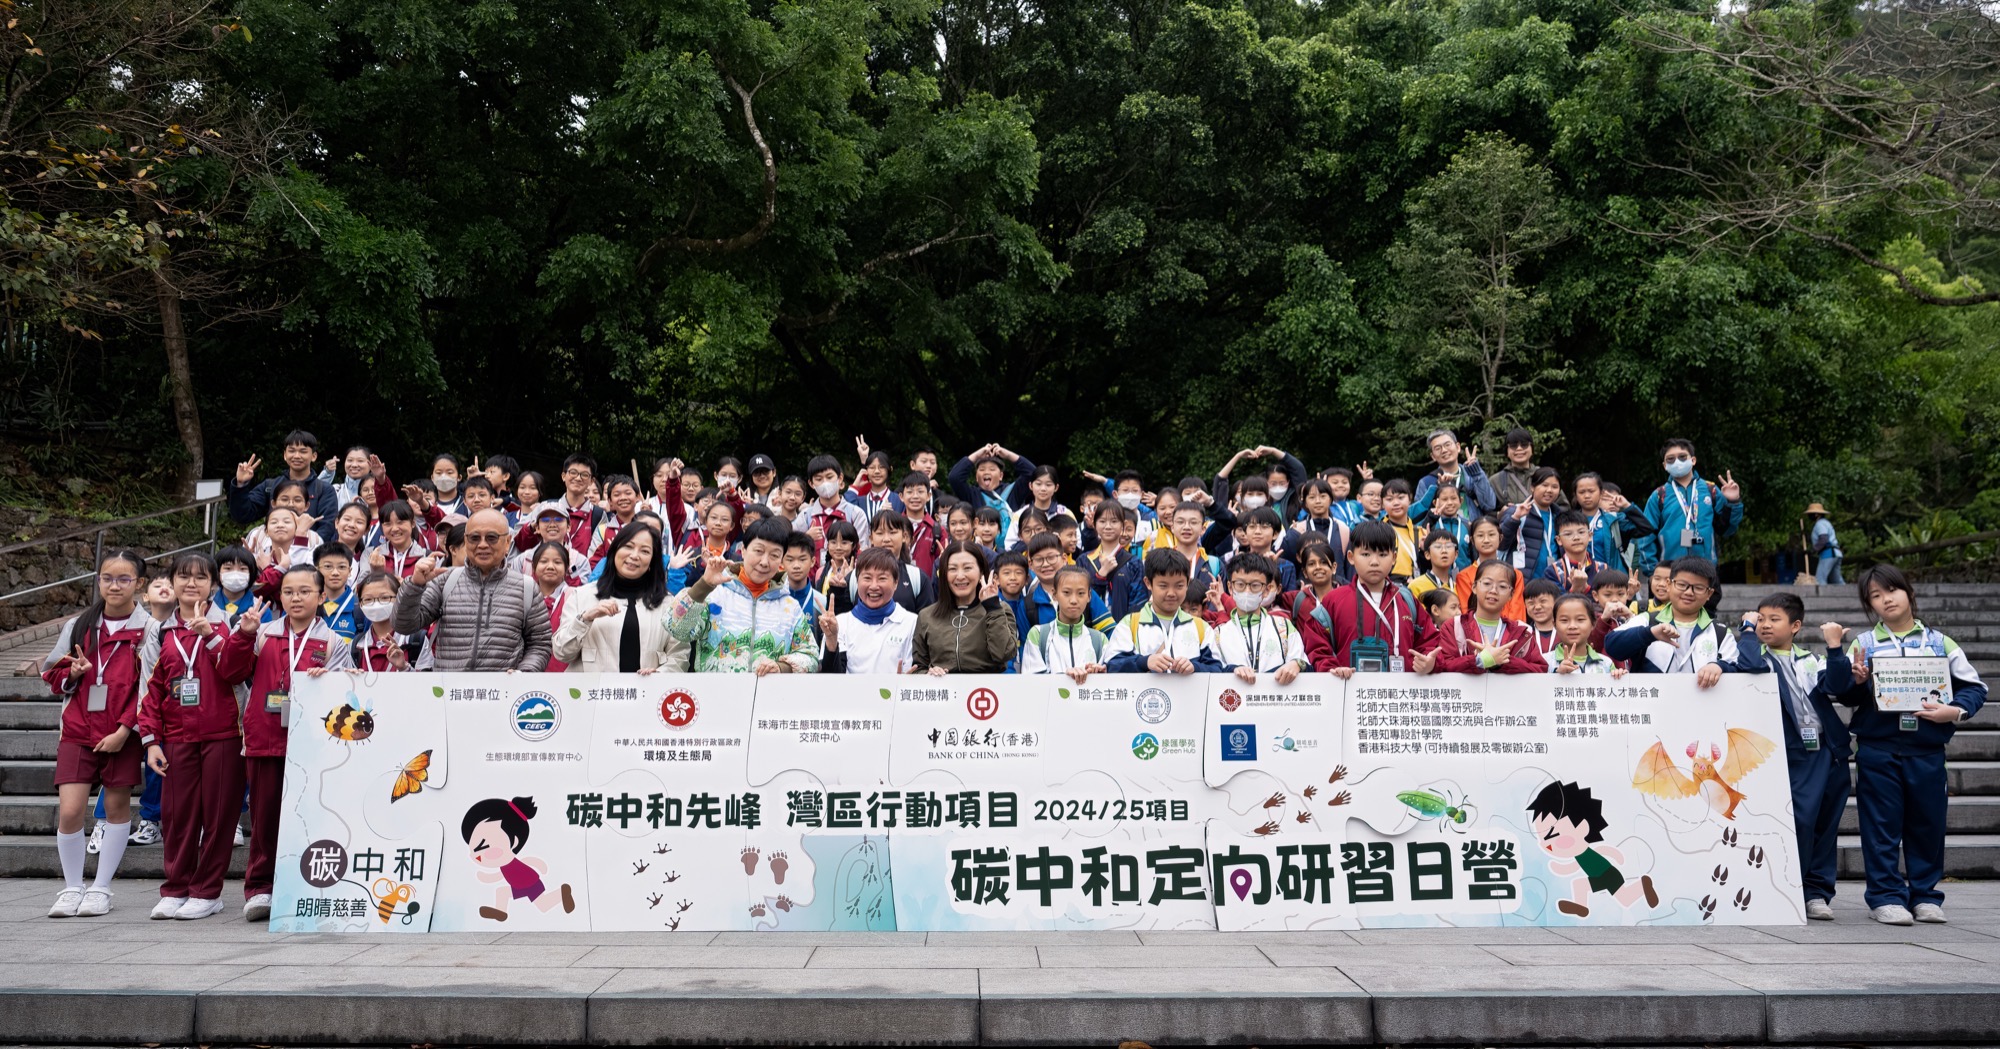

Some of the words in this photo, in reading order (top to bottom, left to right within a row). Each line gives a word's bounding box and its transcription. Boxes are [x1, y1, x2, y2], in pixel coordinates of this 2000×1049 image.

[1356, 687, 1461, 700] 北京師範大學環境學院
[1554, 686, 1659, 698] 深圳市專家人才聯合會
[1357, 701, 1483, 713] 北師大自然科學高等研究院
[1555, 700, 1597, 711] 朗晴慈善
[758, 719, 882, 731] 珠海市生態環境宣傳教育和
[1357, 715, 1537, 727] 北師大珠海校區國際交流與合作辦公室
[1556, 713, 1651, 725] 嘉道理農場暨植物園
[524, 722, 547, 730] CEEC
[799, 732, 841, 743] 交流中心
[1358, 728, 1442, 740] 香港知專設計學院
[1556, 727, 1599, 738] 綠匯學苑
[614, 738, 741, 747] 中華人民共和國香港特別行政區政府
[485, 752, 583, 762] 生態環境部宣傳教育中心
[644, 750, 712, 761] 環境及生態局
[928, 751, 953, 760] BANK
[955, 751, 967, 760] OF
[970, 751, 1000, 759] CHINA
[566, 792, 761, 830] 碳中和先峰
[786, 790, 1018, 828] 灣區行動項目
[1033, 799, 1189, 821] 2024/25項目
[309, 847, 425, 882] 碳中和
[951, 840, 1517, 907] 碳中和定向研習日營
[295, 897, 367, 918] 朗晴慈善
